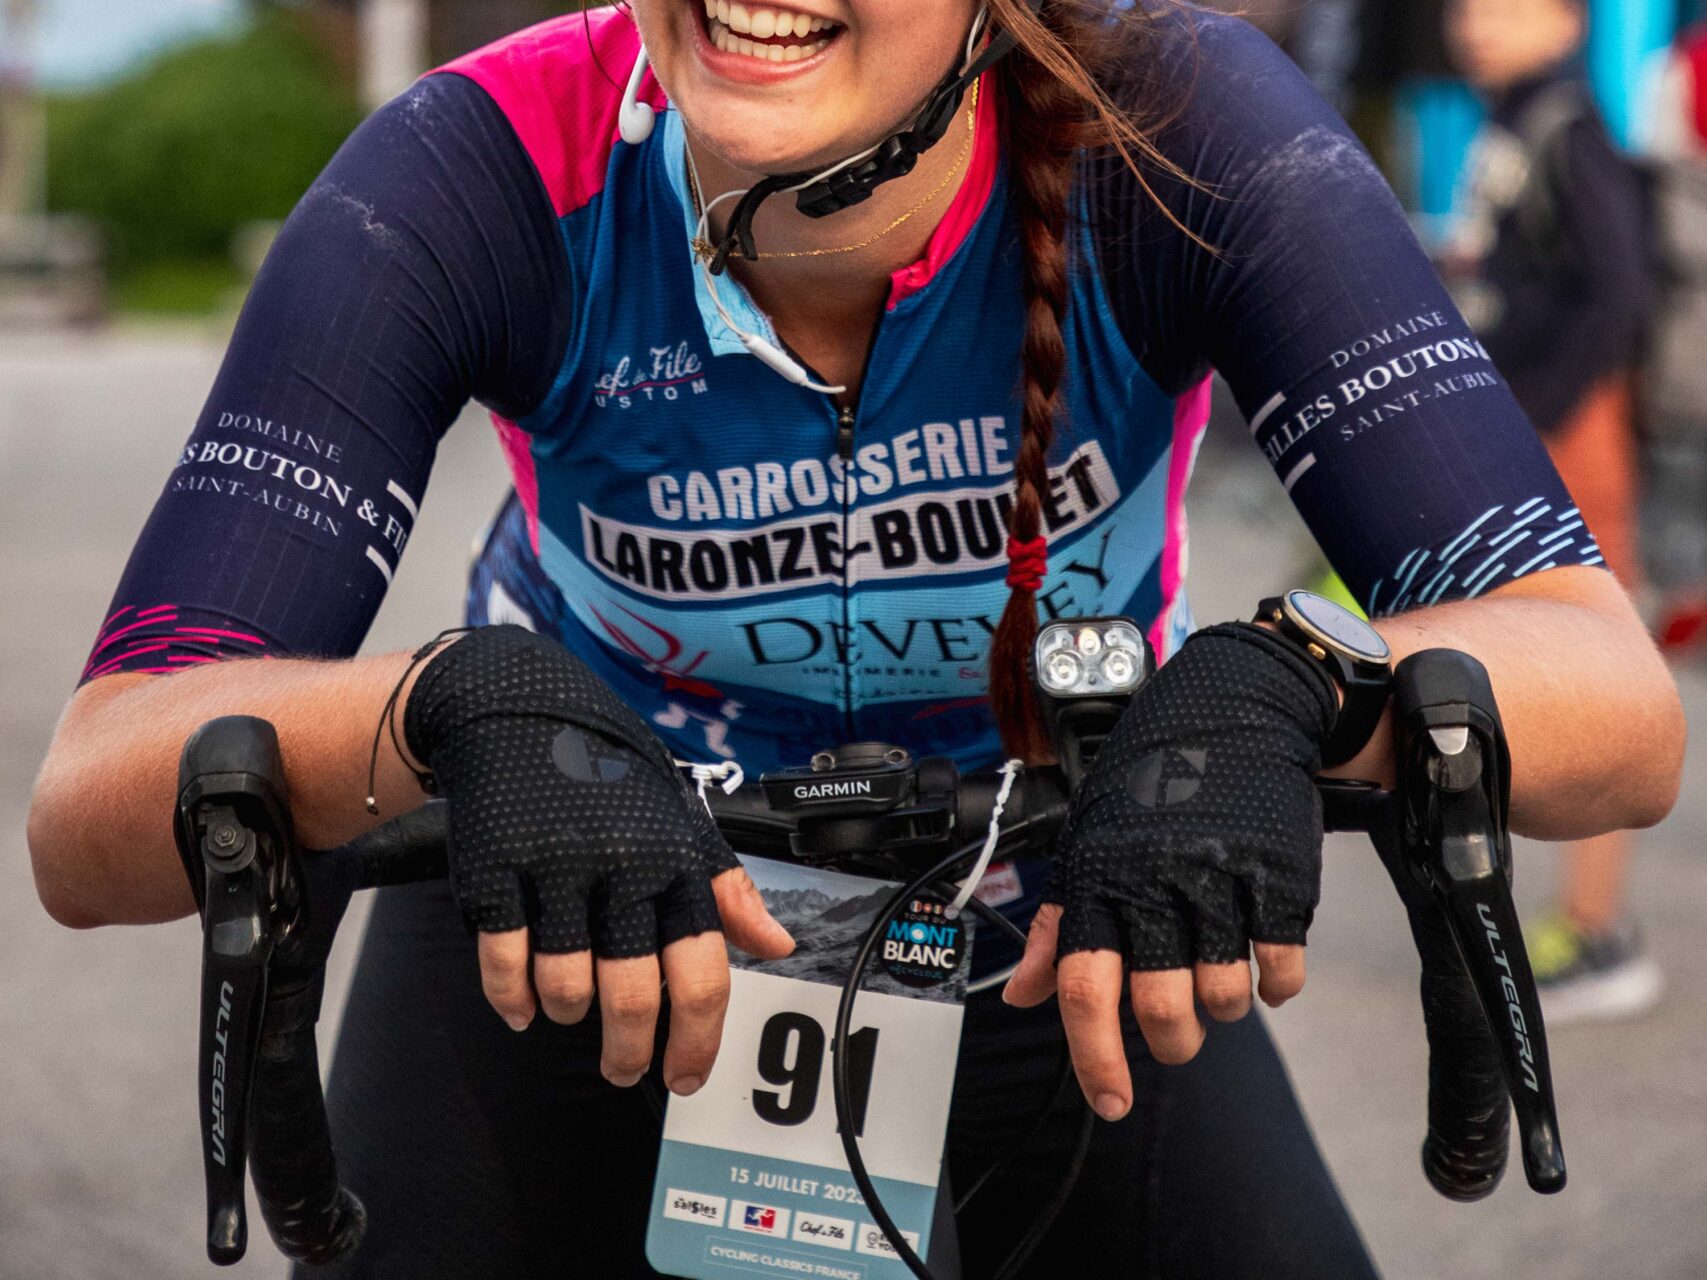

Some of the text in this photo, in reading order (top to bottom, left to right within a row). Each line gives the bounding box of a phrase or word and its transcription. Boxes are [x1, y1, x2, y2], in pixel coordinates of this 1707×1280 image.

[649, 340, 702, 380] File
[1330, 311, 1448, 369] DOMAINE
[595, 378, 708, 408] USTOM
[1264, 337, 1479, 462] ILLES BOUTON
[1340, 371, 1498, 441] SAINT-AUBIN
[217, 412, 343, 463] DOMAINE
[197, 441, 353, 507] BOUTON
[356, 498, 380, 527] &
[646, 416, 1014, 522] CARROSSERIE
[173, 476, 343, 537] SAINT-AUBIN
[794, 780, 871, 799] GARMIN
[883, 940, 956, 969] BLANC
[886, 920, 958, 948] MONT
[1476, 902, 1539, 1093] ULTEGRA
[211, 980, 235, 1167] ULTEGRA
[751, 1011, 880, 1139] 91
[729, 1166, 749, 1185] 15
[754, 1174, 819, 1197] JUILLET
[711, 1246, 862, 1280] CYCLING CLASSICS FRANCE
